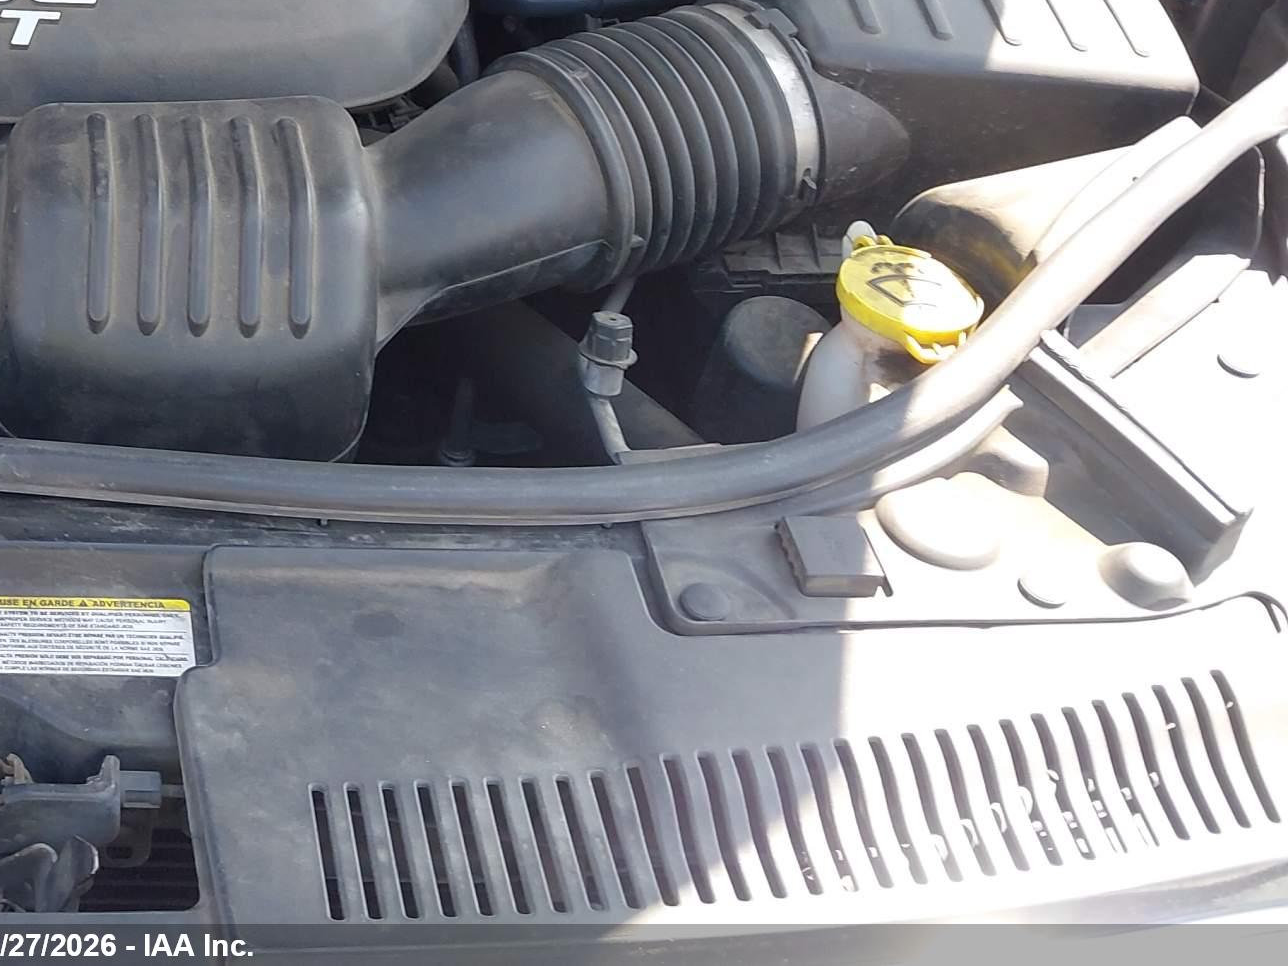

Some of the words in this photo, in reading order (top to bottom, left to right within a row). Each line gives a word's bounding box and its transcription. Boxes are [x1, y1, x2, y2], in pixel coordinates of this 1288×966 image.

[22, 599, 37, 607] EN
[39, 599, 73, 607] GARDE
[92, 600, 166, 609] ADVERTENCIA
